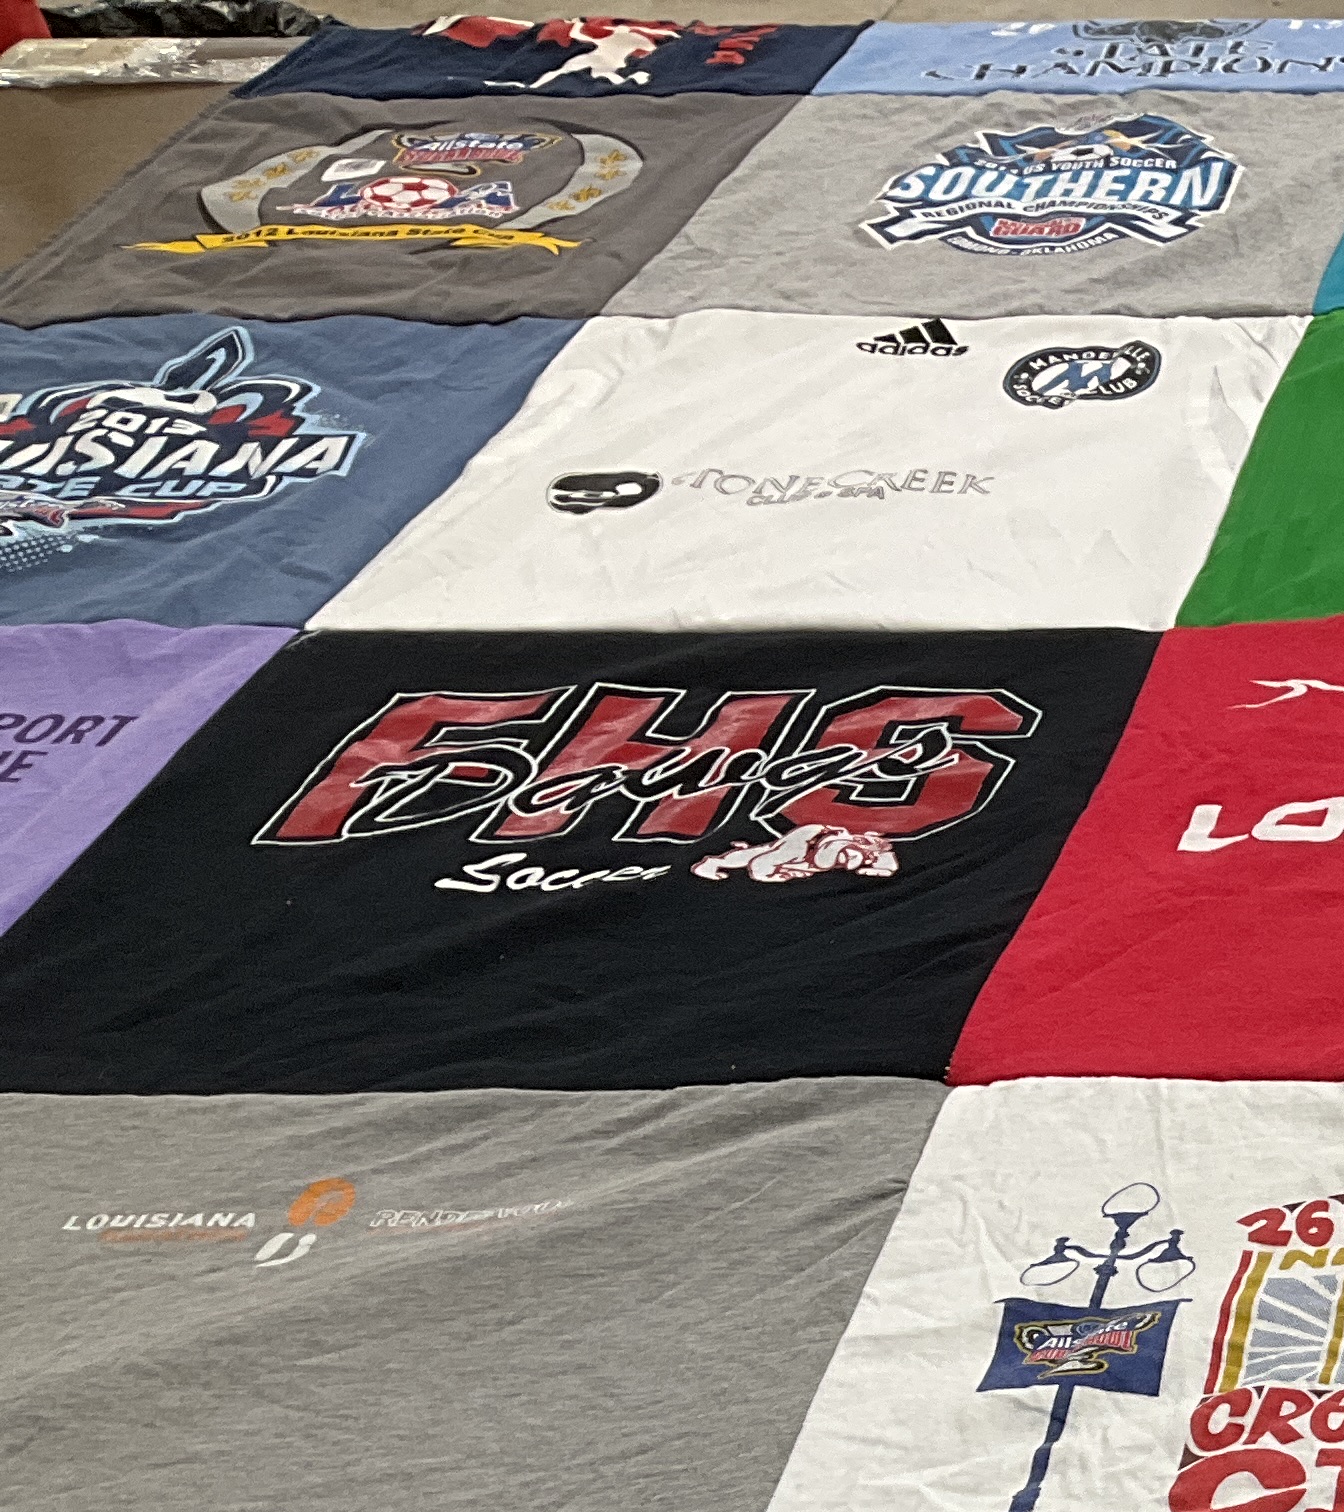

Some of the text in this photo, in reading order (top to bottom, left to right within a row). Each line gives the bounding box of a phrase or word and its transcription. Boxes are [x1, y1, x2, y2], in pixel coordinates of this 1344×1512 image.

[1111, 155, 1177, 169] SOCCER
[887, 162, 1223, 206] SOUTHERN
[922, 199, 1169, 220] REGIONAL CHAMPIONSHIPS
[856, 341, 969, 357] adidas
[66, 409, 207, 437] 2013
[115, 481, 247, 498] CUP
[251, 683, 1043, 847] FHS
[434, 854, 672, 893] Soccer
[63, 1211, 257, 1231] LOUISIANA
[1239, 1205, 1334, 1248] 26
